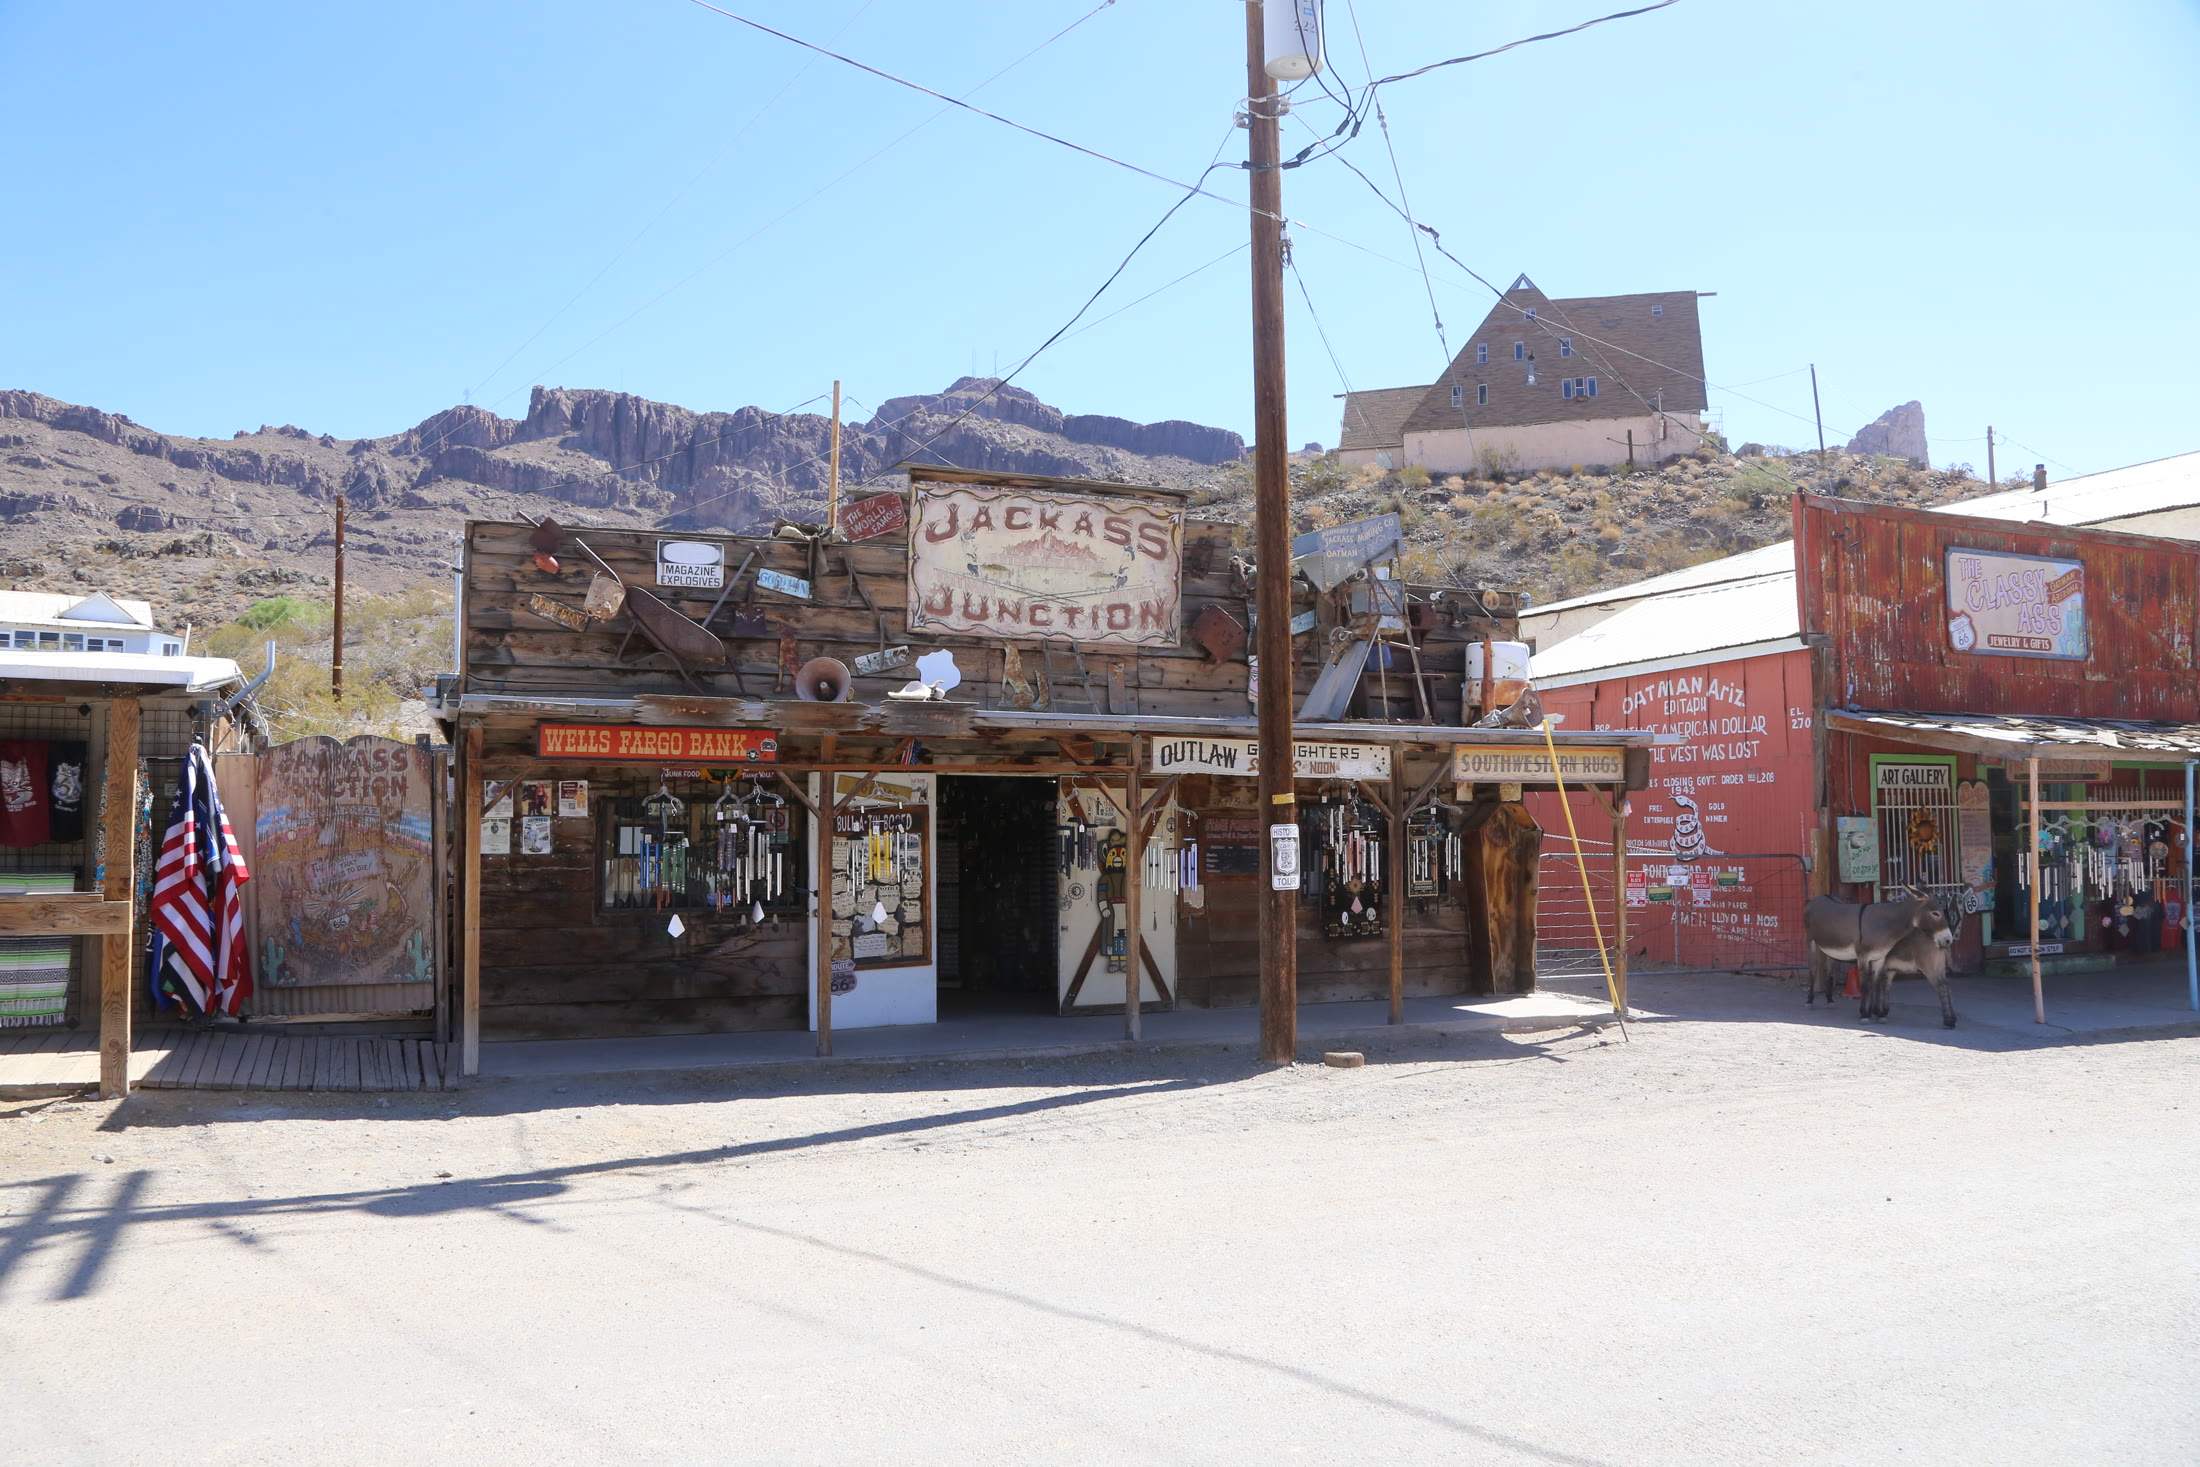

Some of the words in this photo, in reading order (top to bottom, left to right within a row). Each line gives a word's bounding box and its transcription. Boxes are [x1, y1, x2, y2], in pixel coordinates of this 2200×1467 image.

[846, 509, 863, 526] THE
[851, 505, 886, 535] WORLD
[871, 507, 902, 534] FAMOUS
[925, 503, 1169, 561] JACKASS
[1324, 535, 1354, 547] JACKASS
[1357, 522, 1384, 542] MINING
[1384, 518, 1394, 529] CO
[1326, 549, 1359, 558] OATMAN
[665, 564, 716, 577] MAGAZINE
[1959, 557, 1983, 582] THE
[660, 575, 721, 588] EXPLOSIVES
[2050, 571, 2077, 592] OATMAN
[1966, 568, 2046, 613] CLASSY
[2051, 583, 2080, 604] ARIZONA
[924, 586, 1166, 631] JUNCTION
[2017, 601, 2062, 636] ASS
[1958, 633, 1970, 646] 66
[1989, 635, 2022, 648] JEWELRY
[2023, 637, 2028, 648] &
[2030, 638, 2051, 650] GIFTS
[1622, 676, 1703, 716] OATMAN
[1706, 678, 1747, 709] Ariz.
[1663, 697, 1707, 716] EPITAPH
[1662, 719, 1718, 740] AMERICAN
[1722, 715, 1768, 736] DOLLAR
[1791, 717, 1812, 730] 270
[544, 728, 611, 753] WELLS
[618, 731, 684, 756] FARGO
[689, 732, 748, 757] BANK
[1160, 740, 1238, 769] OUTLAW
[1247, 743, 1361, 760] GIGHTERS
[1649, 747, 1666, 763] THE
[1669, 745, 1699, 763] WEST
[1702, 744, 1725, 761] WAS
[1728, 740, 1761, 759] LOST
[664, 768, 683, 778] JUNK
[683, 768, 701, 778] FOOD
[1309, 762, 1336, 775] NOON
[1582, 755, 1620, 774] RUGS
[2080, 759, 2108, 772] ASS
[1663, 776, 1694, 788] CLOSING
[1721, 774, 1745, 784] ORDER
[1881, 768, 1900, 785] ART
[1902, 768, 1947, 785] GALLERY
[1671, 786, 1696, 795] 1942
[1708, 802, 1725, 811] GOLD
[1705, 815, 1728, 823] MINER
[1277, 877, 1297, 886] TOUR
[1965, 896, 1978, 912] 66
[831, 979, 850, 993] 66
